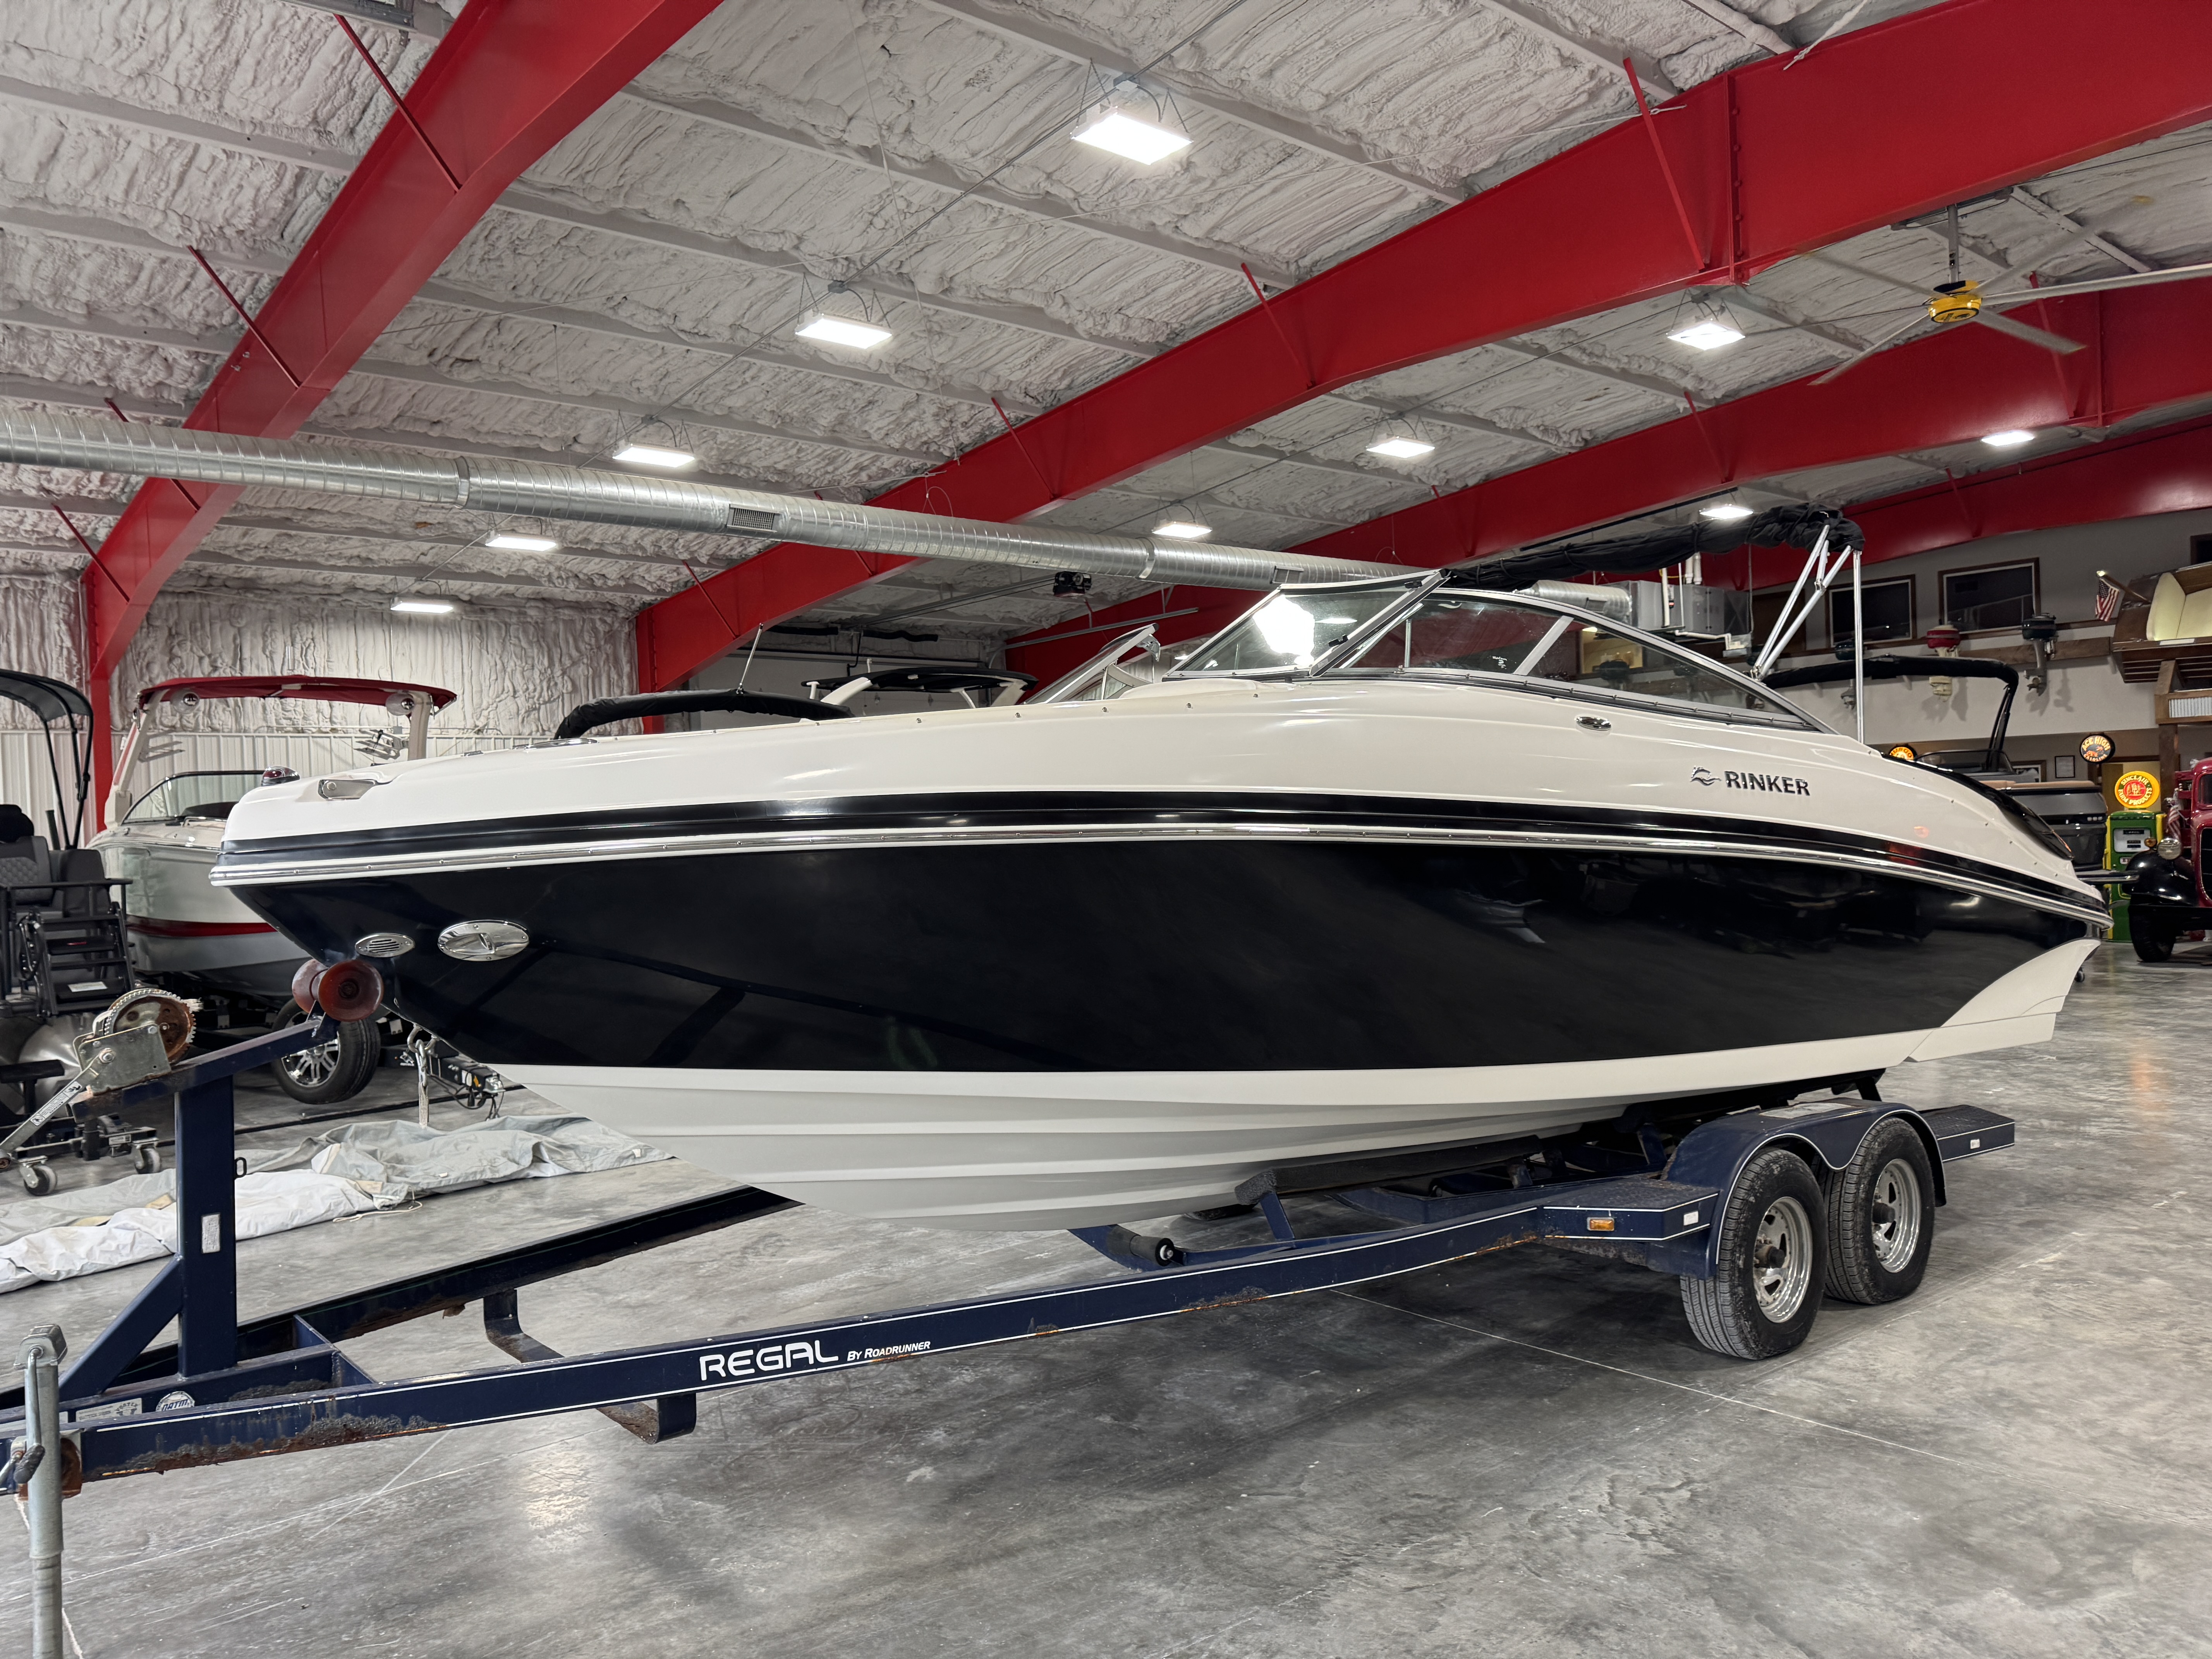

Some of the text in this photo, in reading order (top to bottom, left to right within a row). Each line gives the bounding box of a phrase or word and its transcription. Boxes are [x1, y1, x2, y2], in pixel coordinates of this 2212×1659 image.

[2082, 736, 2111, 751] ACE HIGH
[1724, 771, 1810, 796] RINKER
[2121, 775, 2149, 786] SINCLAIR
[2118, 787, 2152, 805] FARM PRODUCTS
[699, 1340, 839, 1381] REGAL
